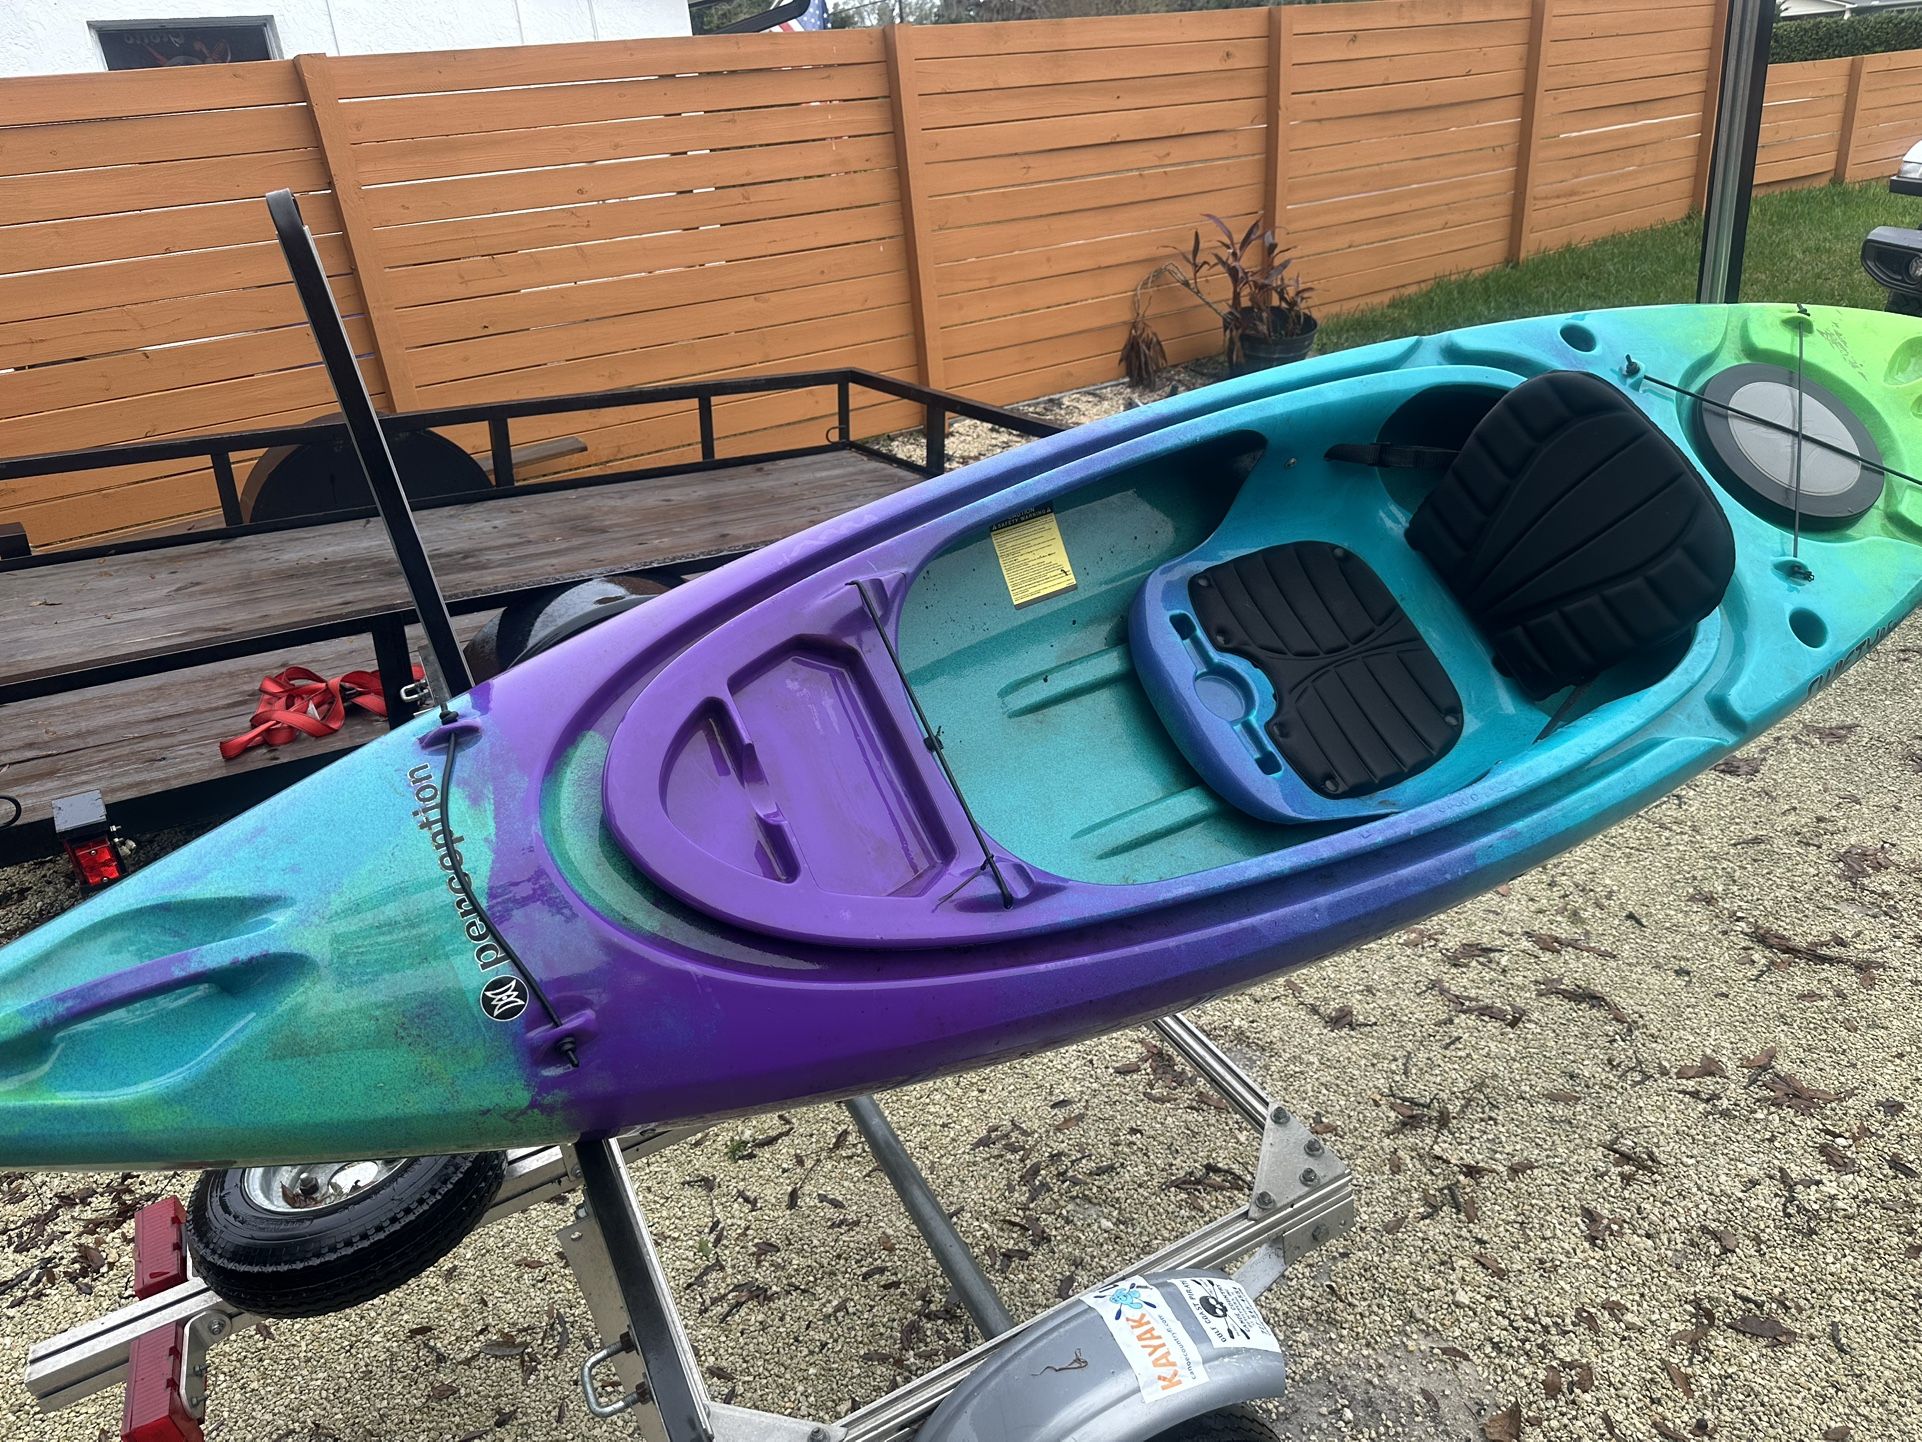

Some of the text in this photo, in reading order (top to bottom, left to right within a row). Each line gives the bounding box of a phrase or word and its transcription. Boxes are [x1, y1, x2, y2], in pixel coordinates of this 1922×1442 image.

[1192, 1302, 1211, 1325] COAST
[1211, 1326, 1227, 1343] GULF
[1125, 1312, 1183, 1391] KAYAK
